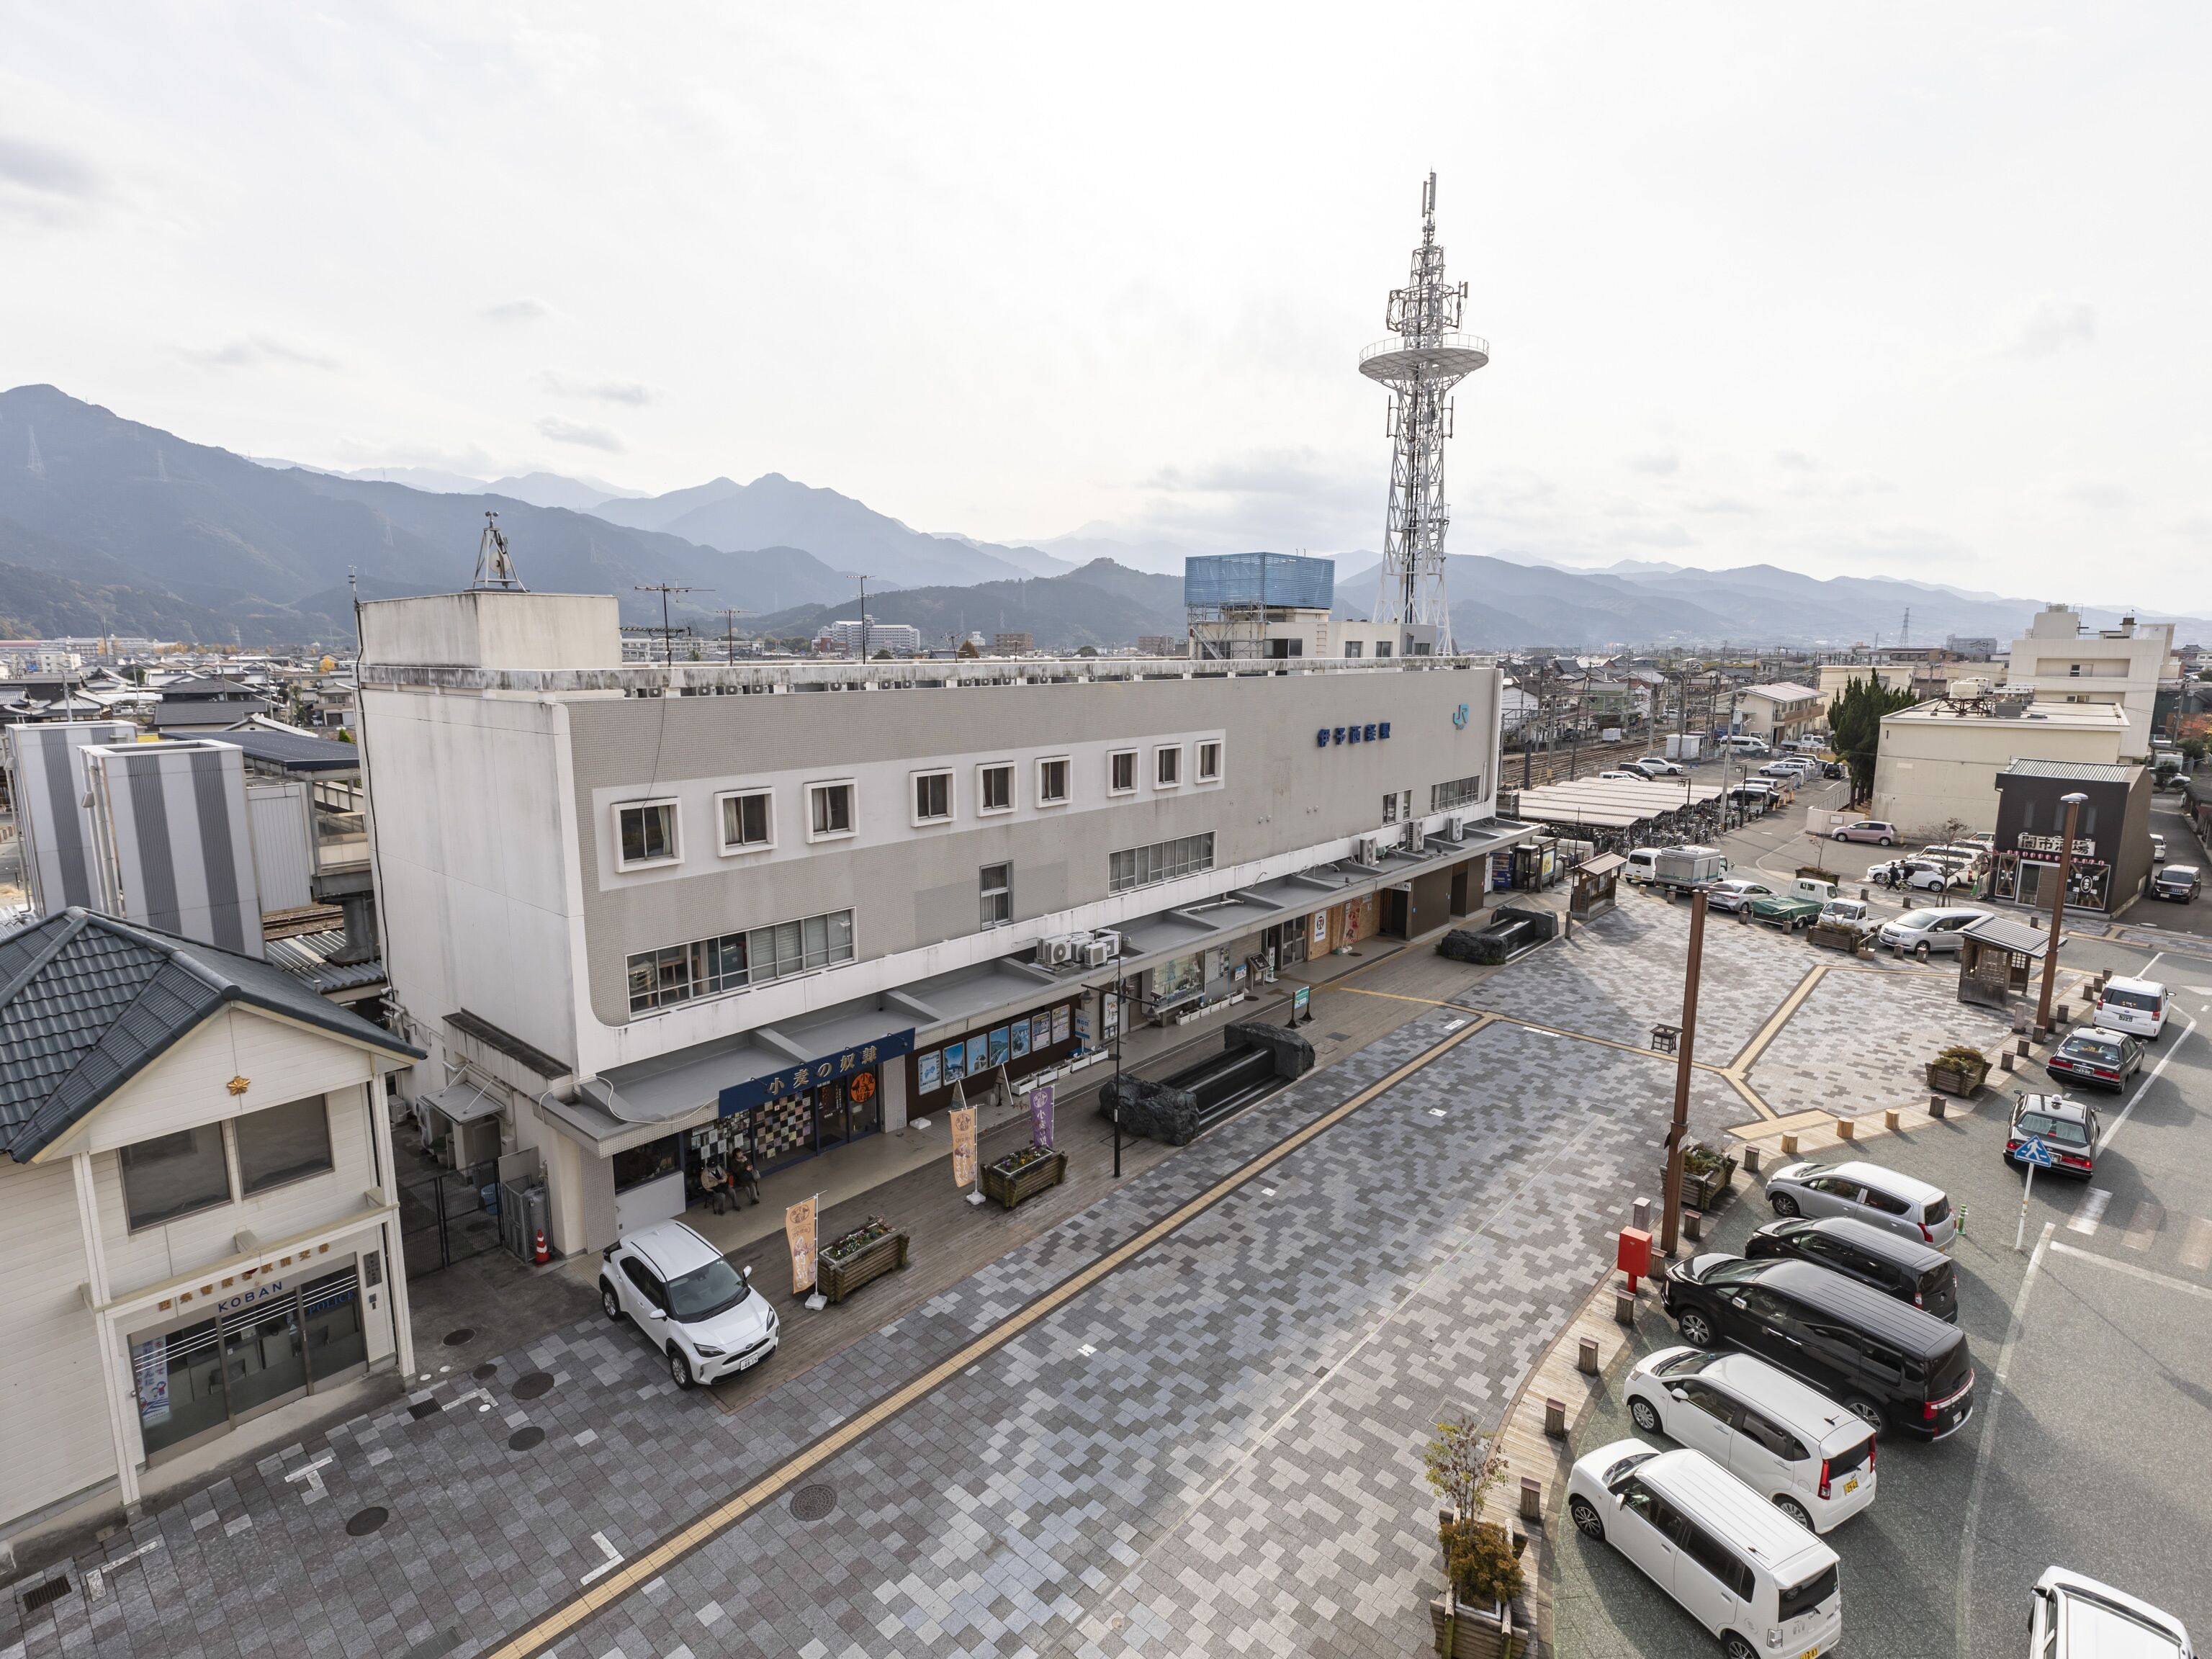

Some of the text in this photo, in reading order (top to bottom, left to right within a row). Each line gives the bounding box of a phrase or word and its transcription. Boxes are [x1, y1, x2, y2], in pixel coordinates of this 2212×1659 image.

[1452, 703, 1470, 725] JR
[1317, 722, 1391, 747] 伊予西条駅
[769, 1046, 878, 1095] 小麦の奴隷
[218, 1281, 282, 1313] KOBAN
[308, 1290, 356, 1316] POLICE
